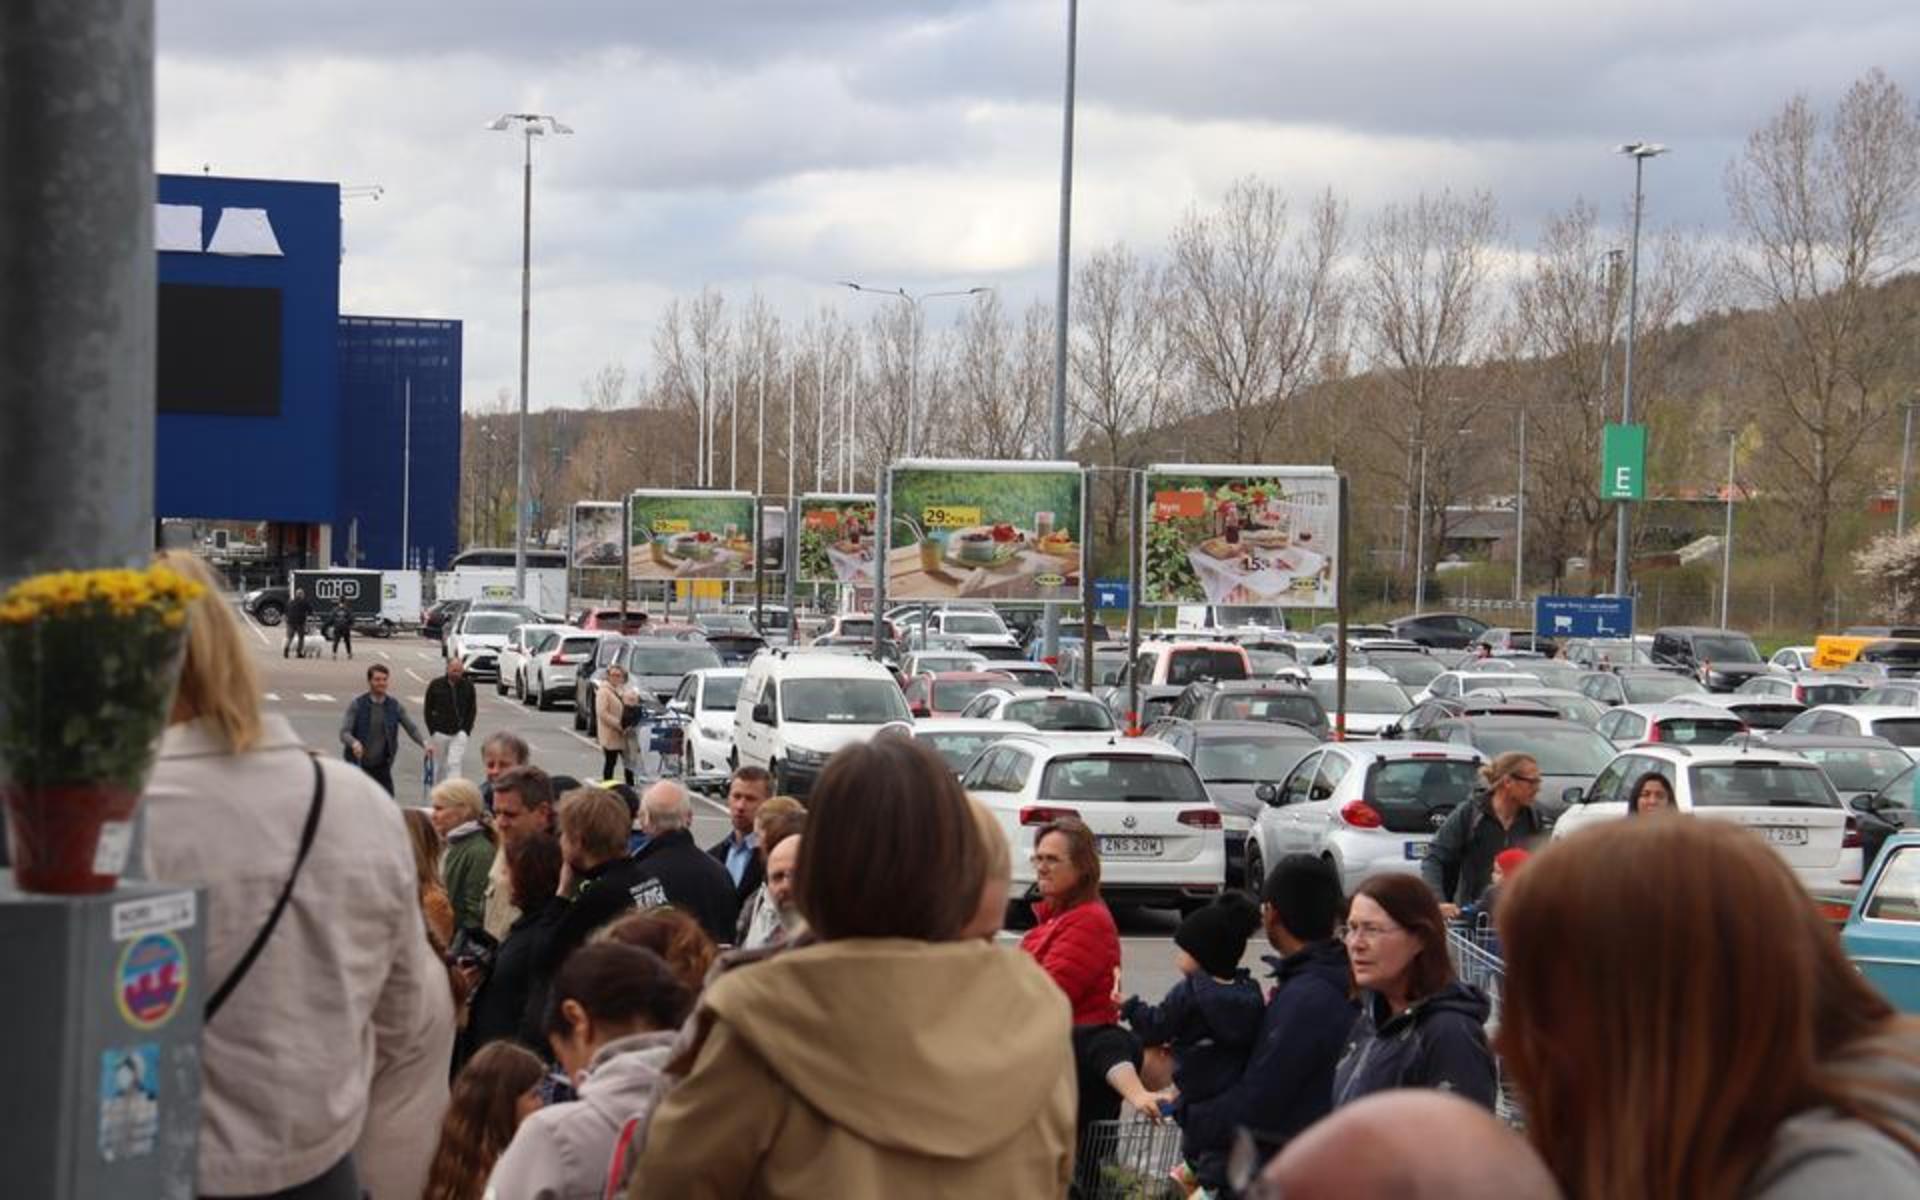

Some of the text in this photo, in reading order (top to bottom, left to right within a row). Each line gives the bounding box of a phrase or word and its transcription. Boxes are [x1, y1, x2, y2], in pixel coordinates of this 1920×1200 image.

[1616, 466, 1632, 490] E
[1105, 838, 1158, 851] ZNS 20W
